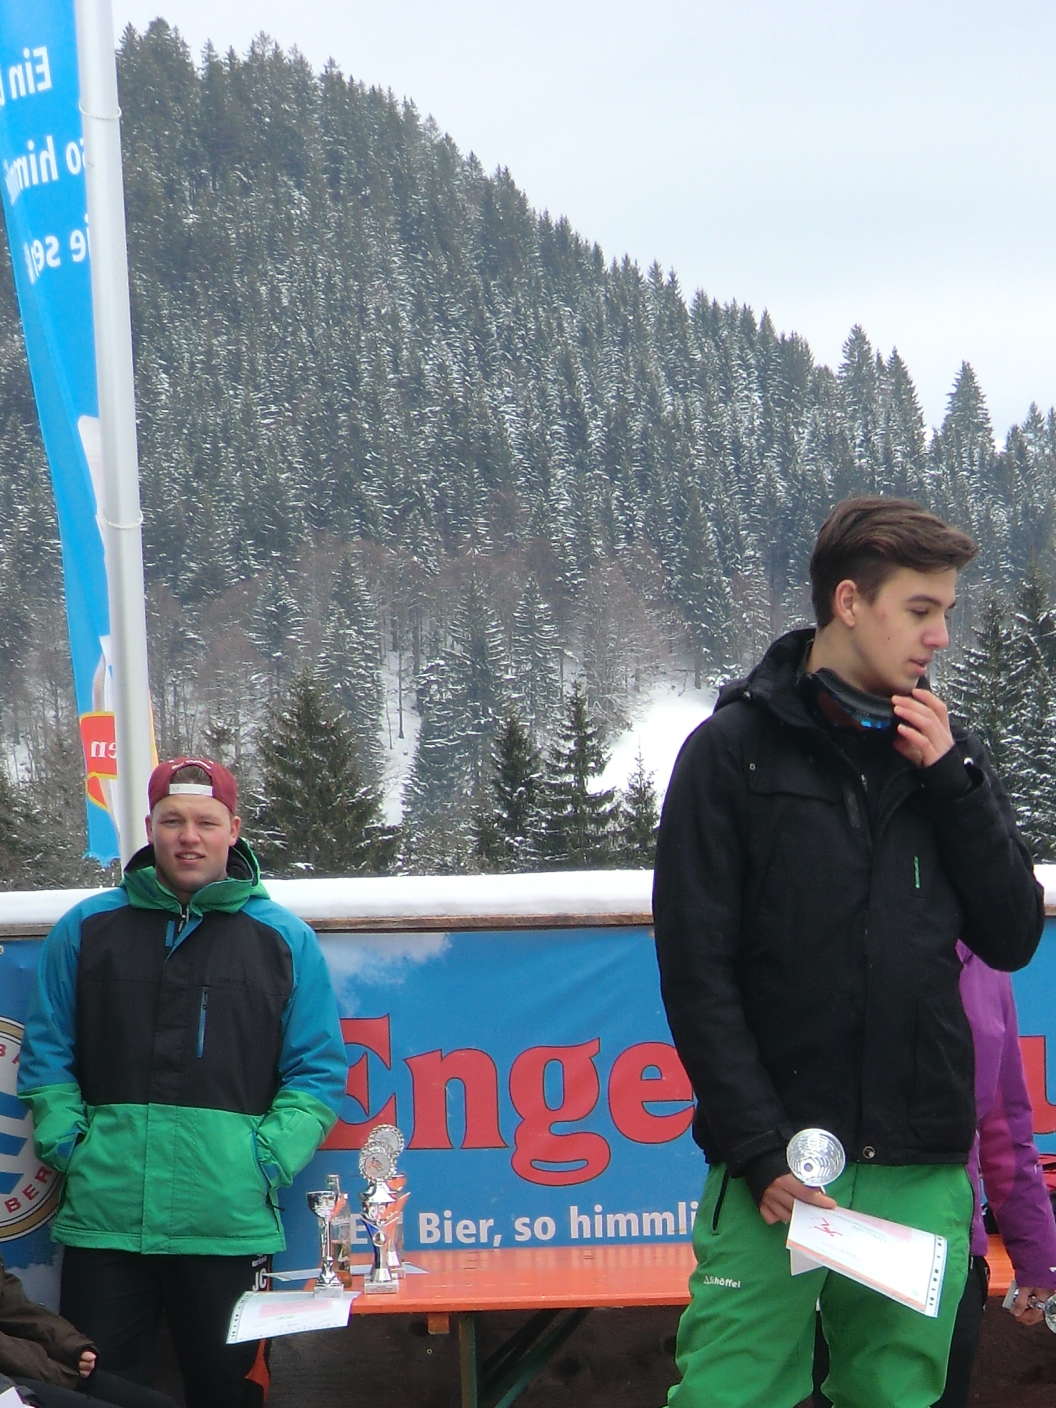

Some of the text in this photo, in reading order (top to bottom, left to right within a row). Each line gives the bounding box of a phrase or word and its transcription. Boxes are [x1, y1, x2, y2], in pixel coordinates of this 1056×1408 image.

[418, 1210, 502, 1249] Bier,
[514, 1216, 556, 1241] so
[570, 1201, 698, 1239] himmli
